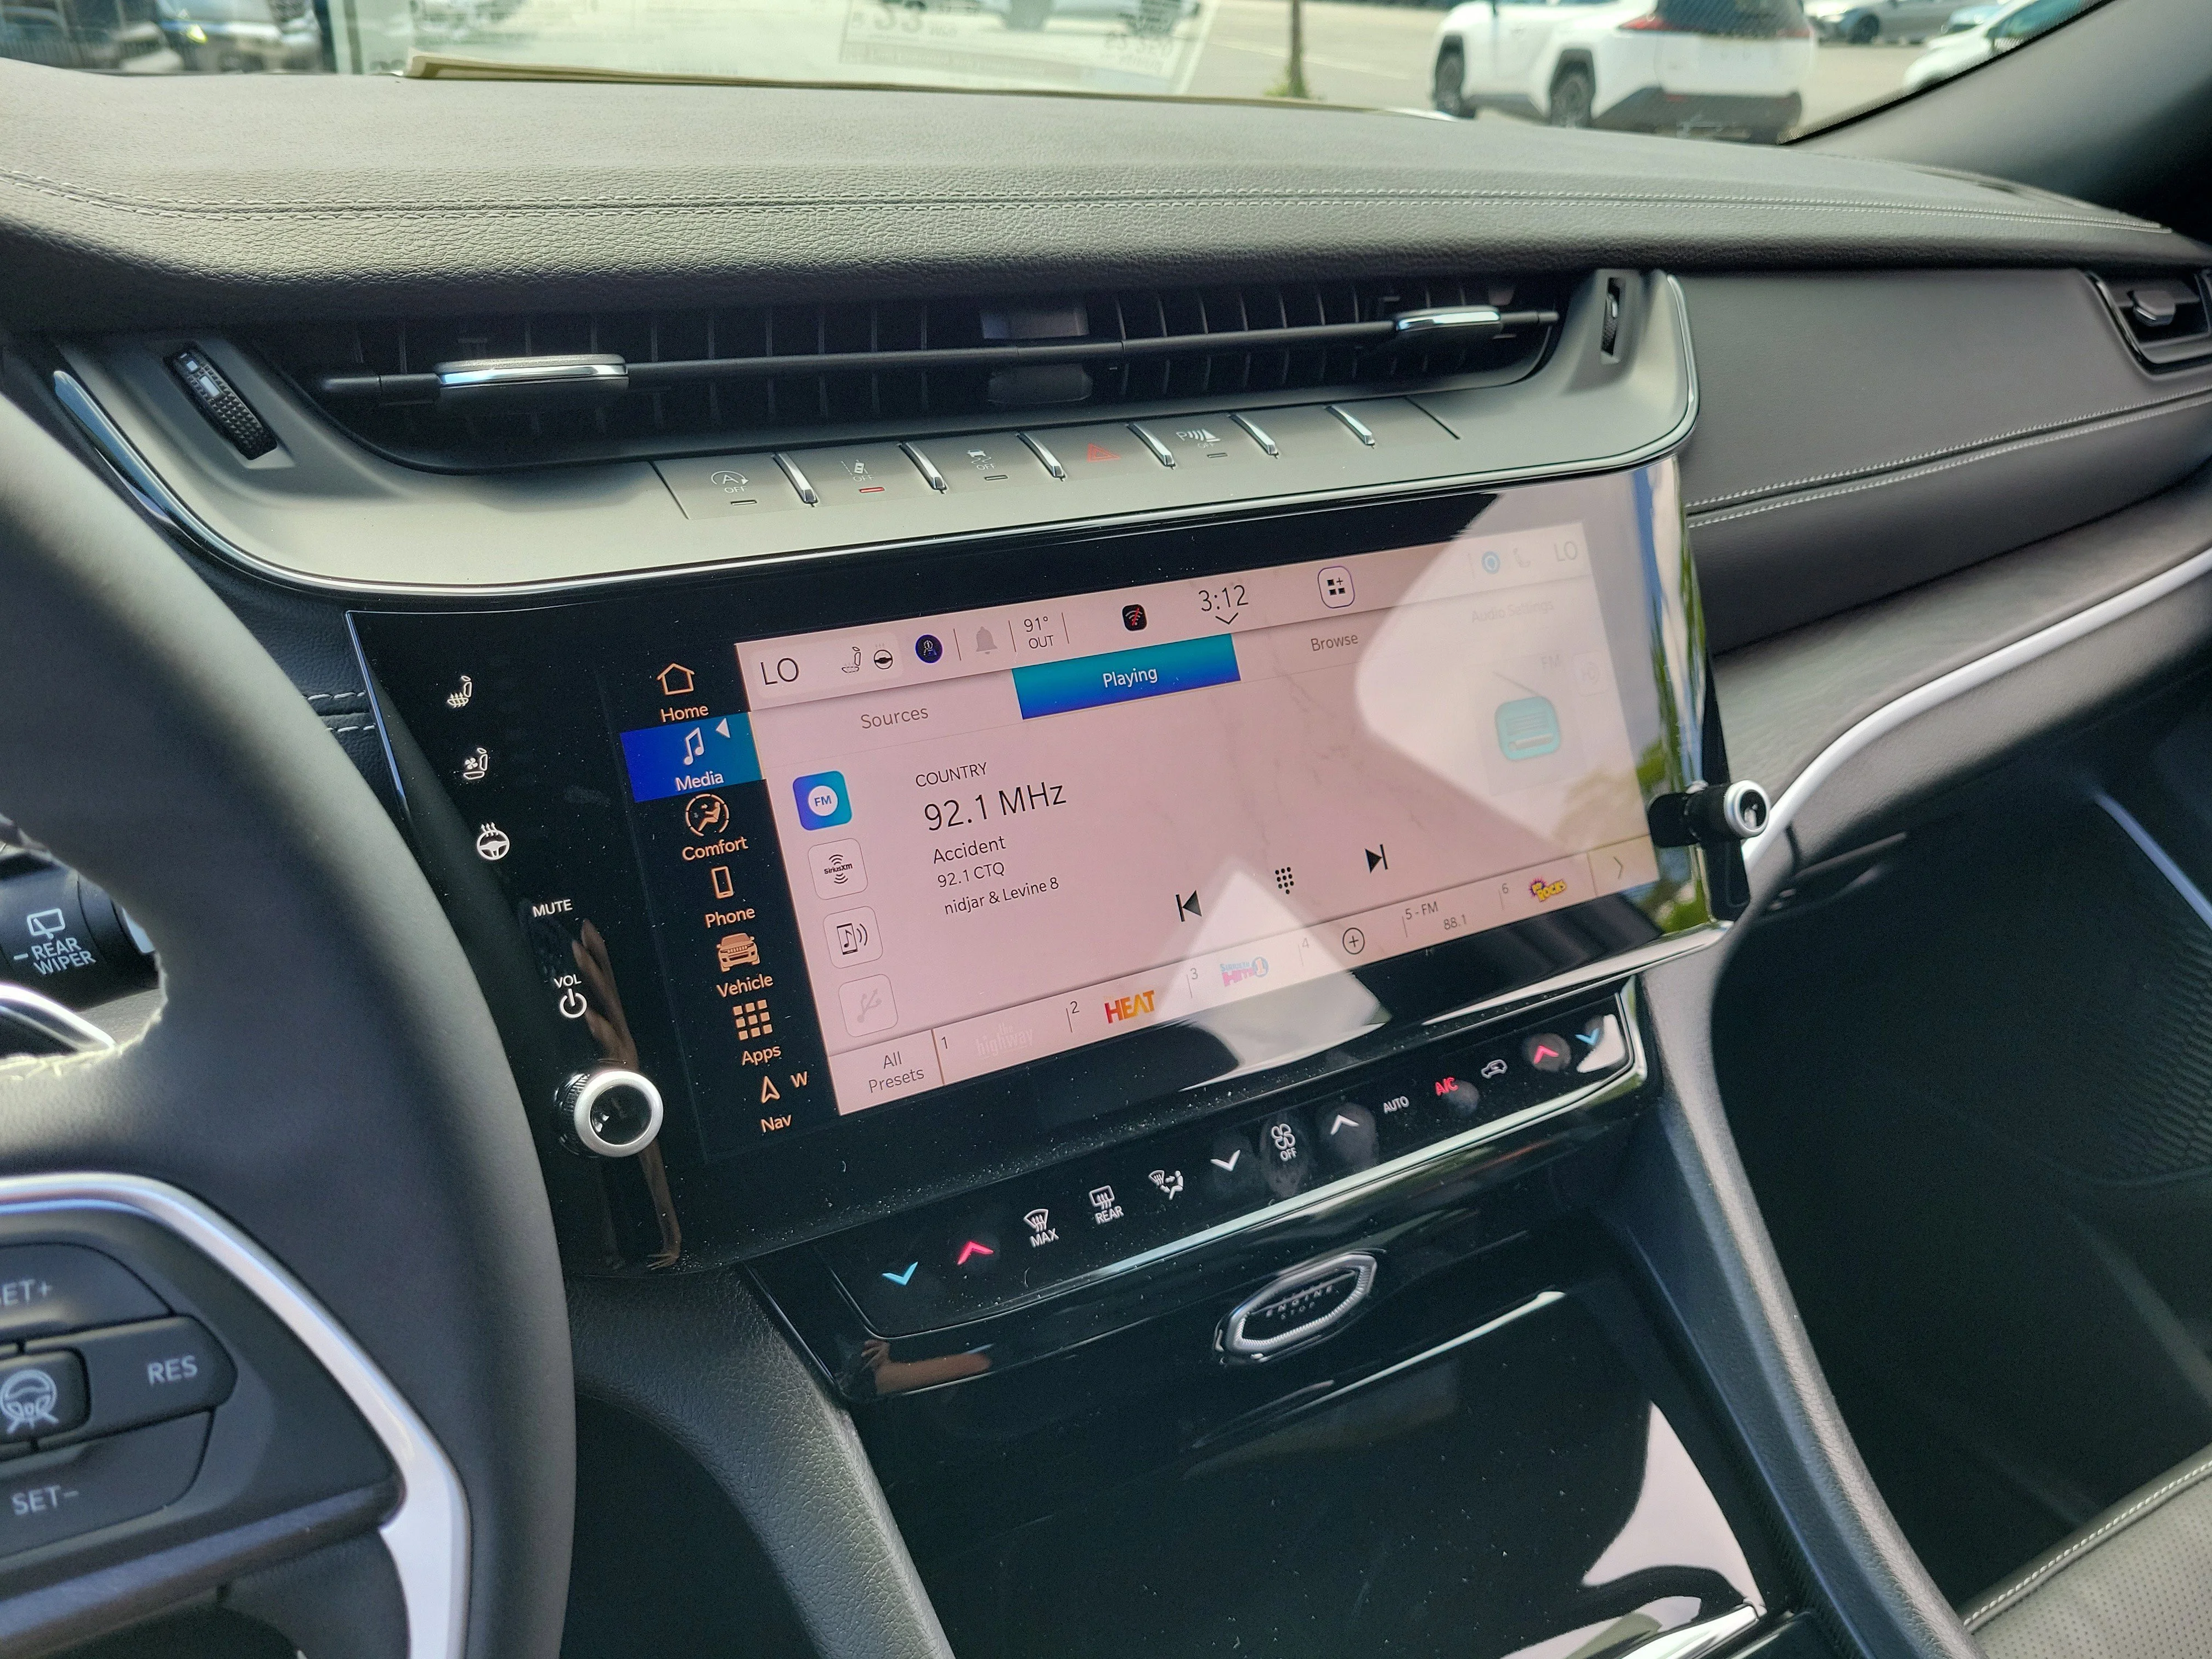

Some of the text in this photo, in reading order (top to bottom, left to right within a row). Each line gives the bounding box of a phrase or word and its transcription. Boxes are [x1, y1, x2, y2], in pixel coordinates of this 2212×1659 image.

[975, 462, 997, 471] OFF
[853, 474, 875, 483] OFF
[1554, 540, 1578, 562] LO
[1198, 584, 1249, 613] 3:12
[1023, 616, 1049, 633] 91°
[1471, 606, 1505, 623] Audio
[1028, 635, 1054, 650] OUT
[1311, 633, 1358, 652] Browse
[760, 658, 799, 685] LO
[1103, 665, 1159, 689] Playing
[660, 704, 709, 723] Home
[860, 706, 929, 730] Sources
[675, 771, 724, 792] Media
[915, 761, 988, 788] COUNTRY
[814, 794, 832, 808] FM
[924, 782, 1066, 832] 92.1 MHz
[682, 836, 749, 862] Comfort
[933, 836, 1006, 865] Accident
[938, 861, 1006, 888] 92.1 CTQ
[944, 876, 1060, 916] nidjar & Levine 8
[1502, 883, 1510, 894] 6
[532, 899, 573, 918] MUTE
[704, 906, 756, 929] Phone
[1405, 908, 1413, 921] 5
[1422, 901, 1439, 916] FM
[1443, 914, 1468, 930] 88.1
[31, 936, 82, 961] REAR
[1301, 937, 1310, 950] 4
[33, 950, 97, 975] WIPER
[554, 973, 583, 989] VOL
[1190, 968, 1199, 980] 3
[716, 974, 774, 998] Vehicle
[1069, 1000, 1080, 1014] 2
[1104, 989, 1155, 1024] HEAT
[941, 1036, 949, 1050] 1
[741, 1045, 781, 1066] Apps
[882, 1051, 903, 1069] All
[791, 1071, 808, 1088] W
[868, 1067, 925, 1093] Presets
[1435, 1076, 1459, 1096] A/C
[1383, 1096, 1410, 1114] AUTO
[760, 1114, 792, 1133] Nav
[1280, 1147, 1297, 1162] OFF
[1095, 1205, 1124, 1224] REAR
[1030, 1227, 1059, 1248] MAX
[0, 1279, 53, 1307] ET+
[146, 1355, 199, 1386] RES
